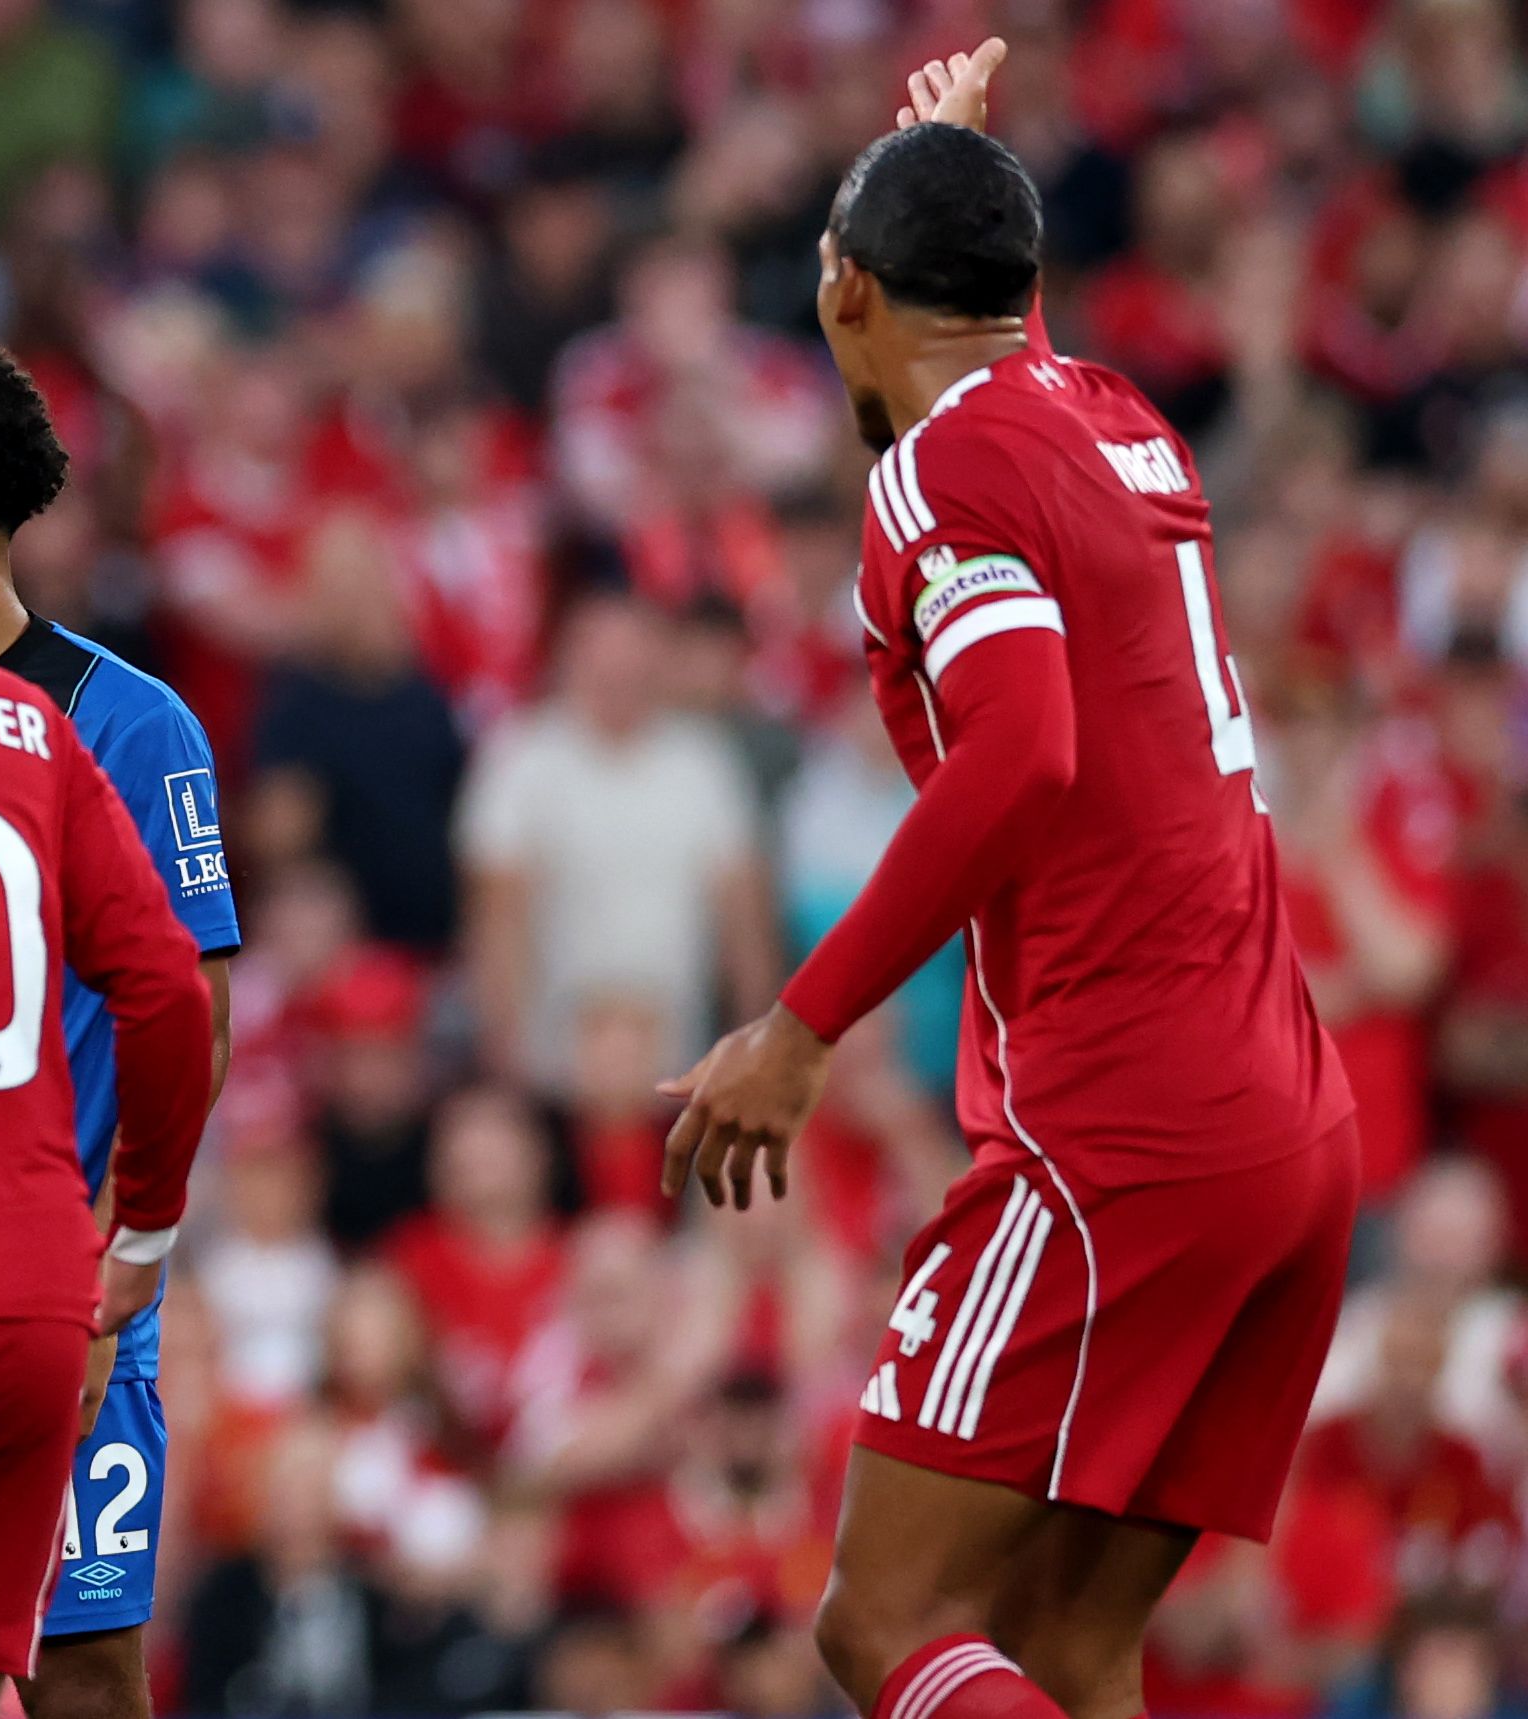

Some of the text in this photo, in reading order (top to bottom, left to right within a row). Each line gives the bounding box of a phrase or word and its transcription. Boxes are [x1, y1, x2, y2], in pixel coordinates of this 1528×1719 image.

[1095, 437, 1190, 494] VIRGIL
[921, 564, 1019, 627] captain
[889, 1241, 952, 1358] 4
[78, 1587, 123, 1601] umbro
